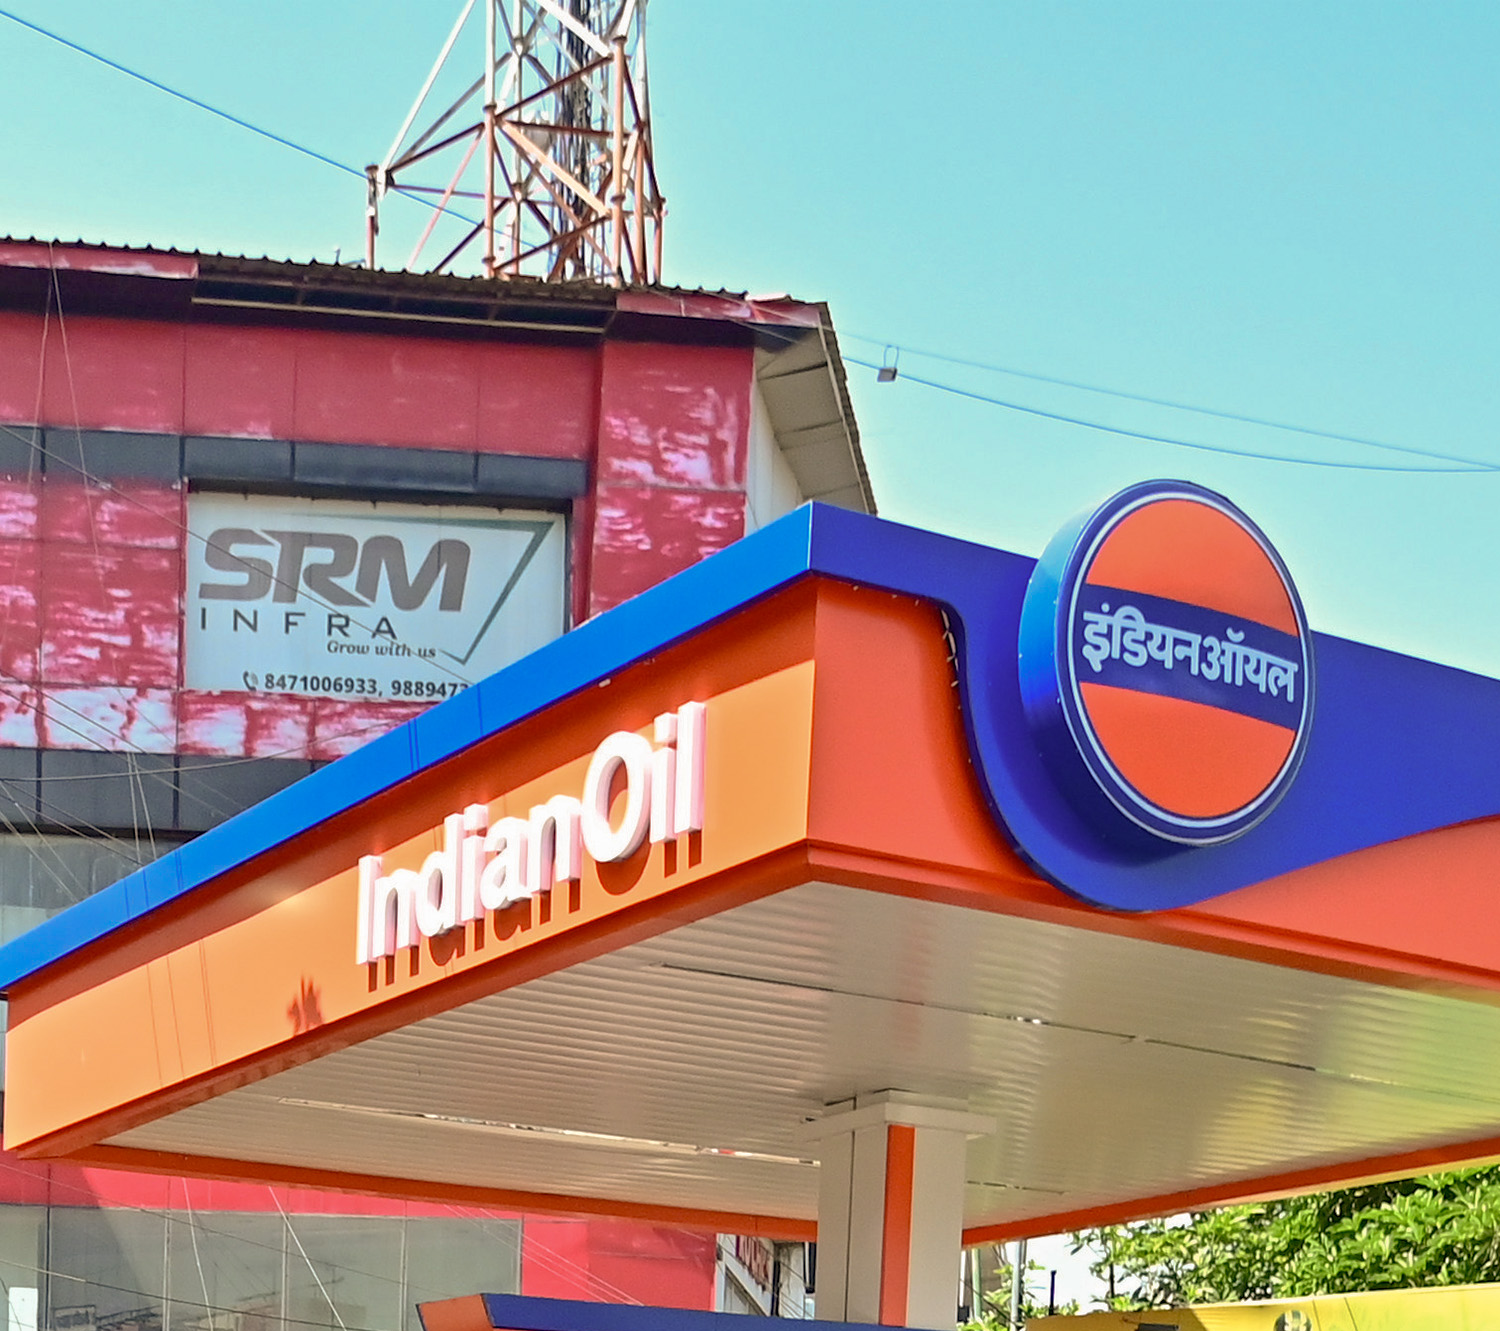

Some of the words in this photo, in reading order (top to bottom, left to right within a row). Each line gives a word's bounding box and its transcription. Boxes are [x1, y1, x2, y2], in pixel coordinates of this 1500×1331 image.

[198, 527, 472, 613] SRM
[199, 606, 399, 641] INFRA
[326, 640, 371, 658] Grow
[373, 640, 413, 658] with
[417, 644, 438, 660] us
[263, 672, 385, 700] 8471006933,
[357, 700, 707, 967] IndianOil
